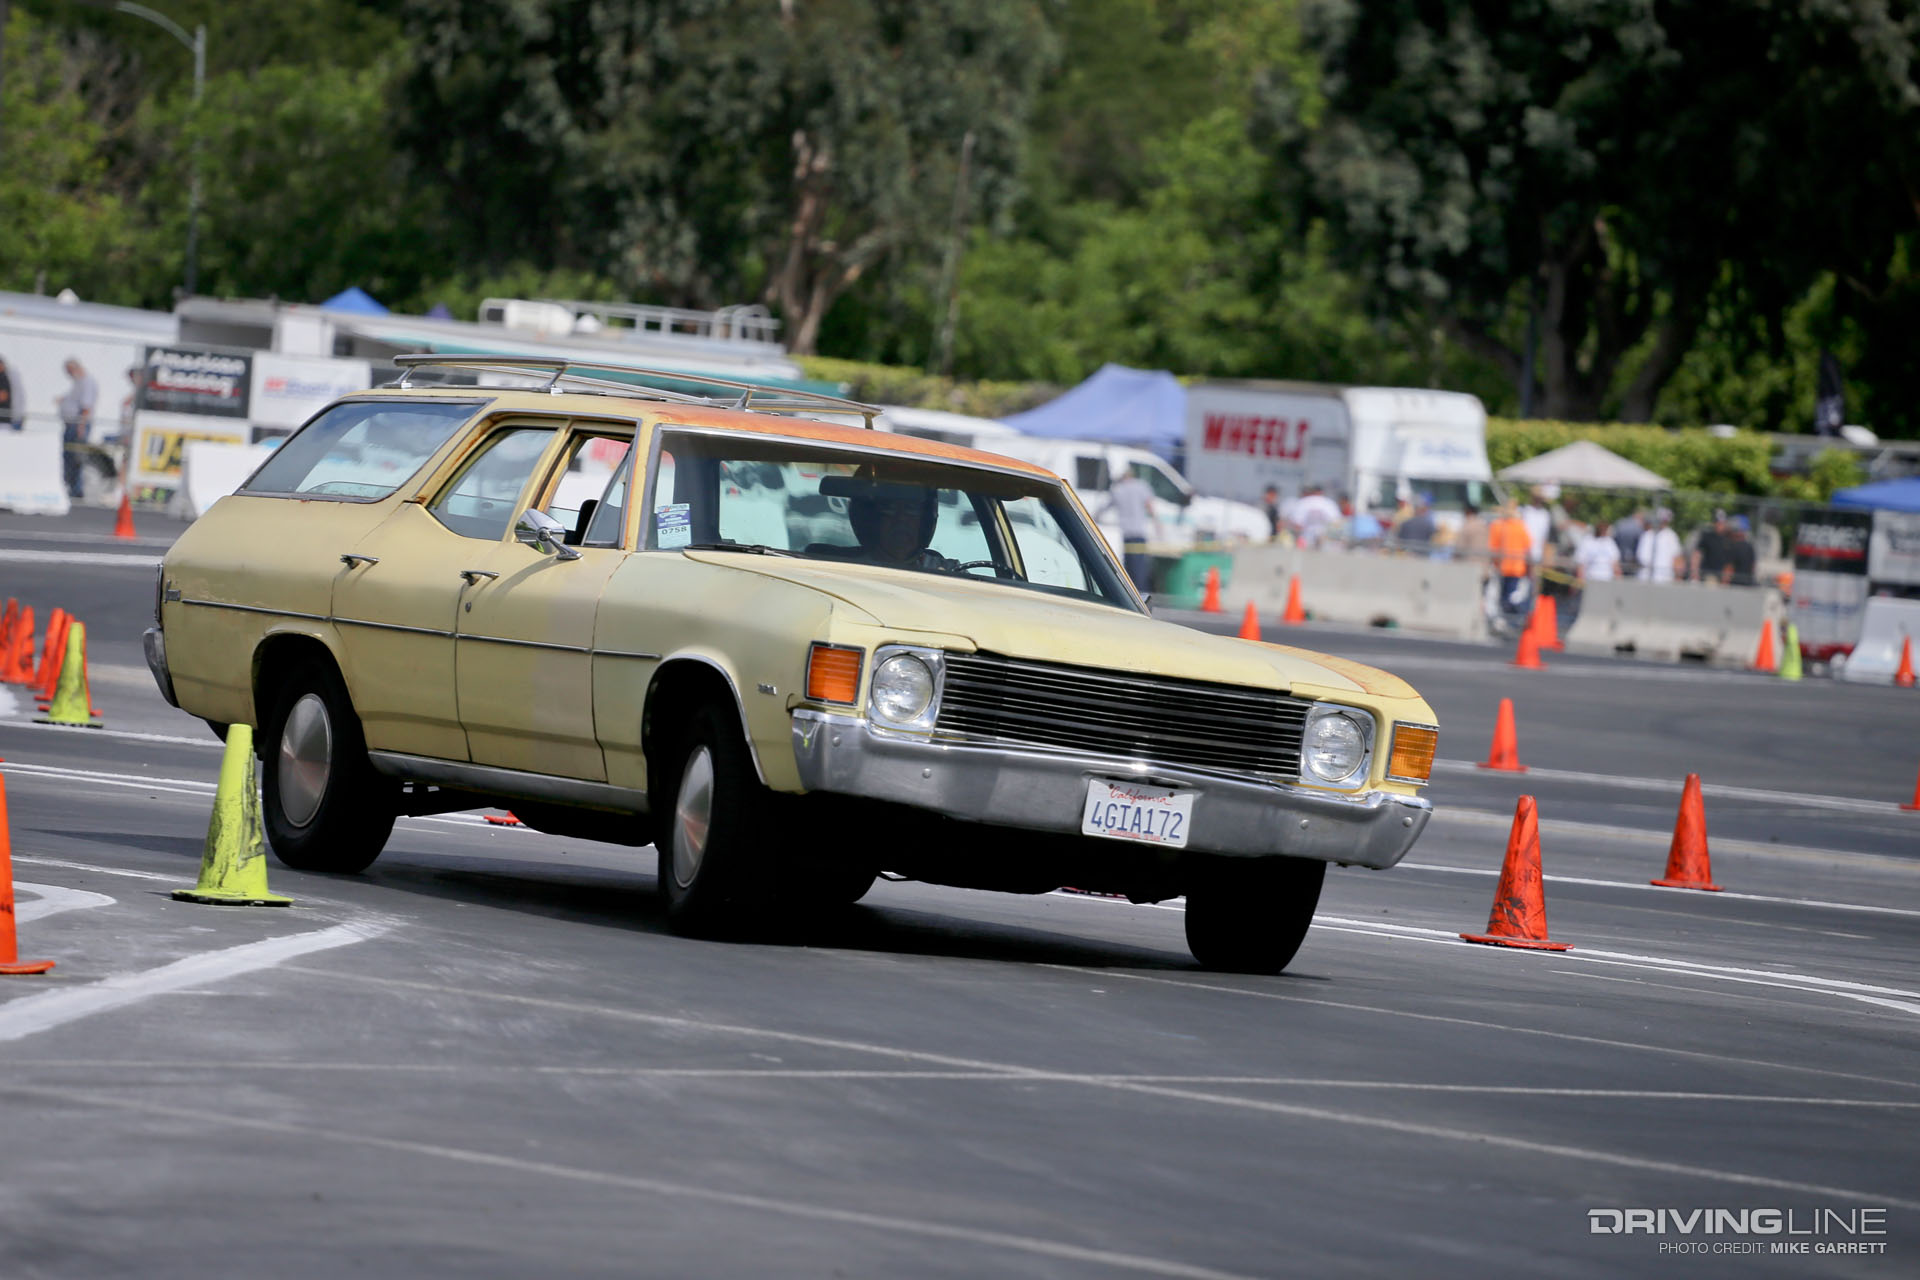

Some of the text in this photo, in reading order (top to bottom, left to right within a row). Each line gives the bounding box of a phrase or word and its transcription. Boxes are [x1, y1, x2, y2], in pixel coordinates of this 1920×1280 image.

[148, 349, 246, 377] American
[1203, 412, 1308, 461] WHEELS
[661, 526, 687, 535] 0758
[1110, 785, 1173, 806] California
[1091, 801, 1183, 839] 4GIA172
